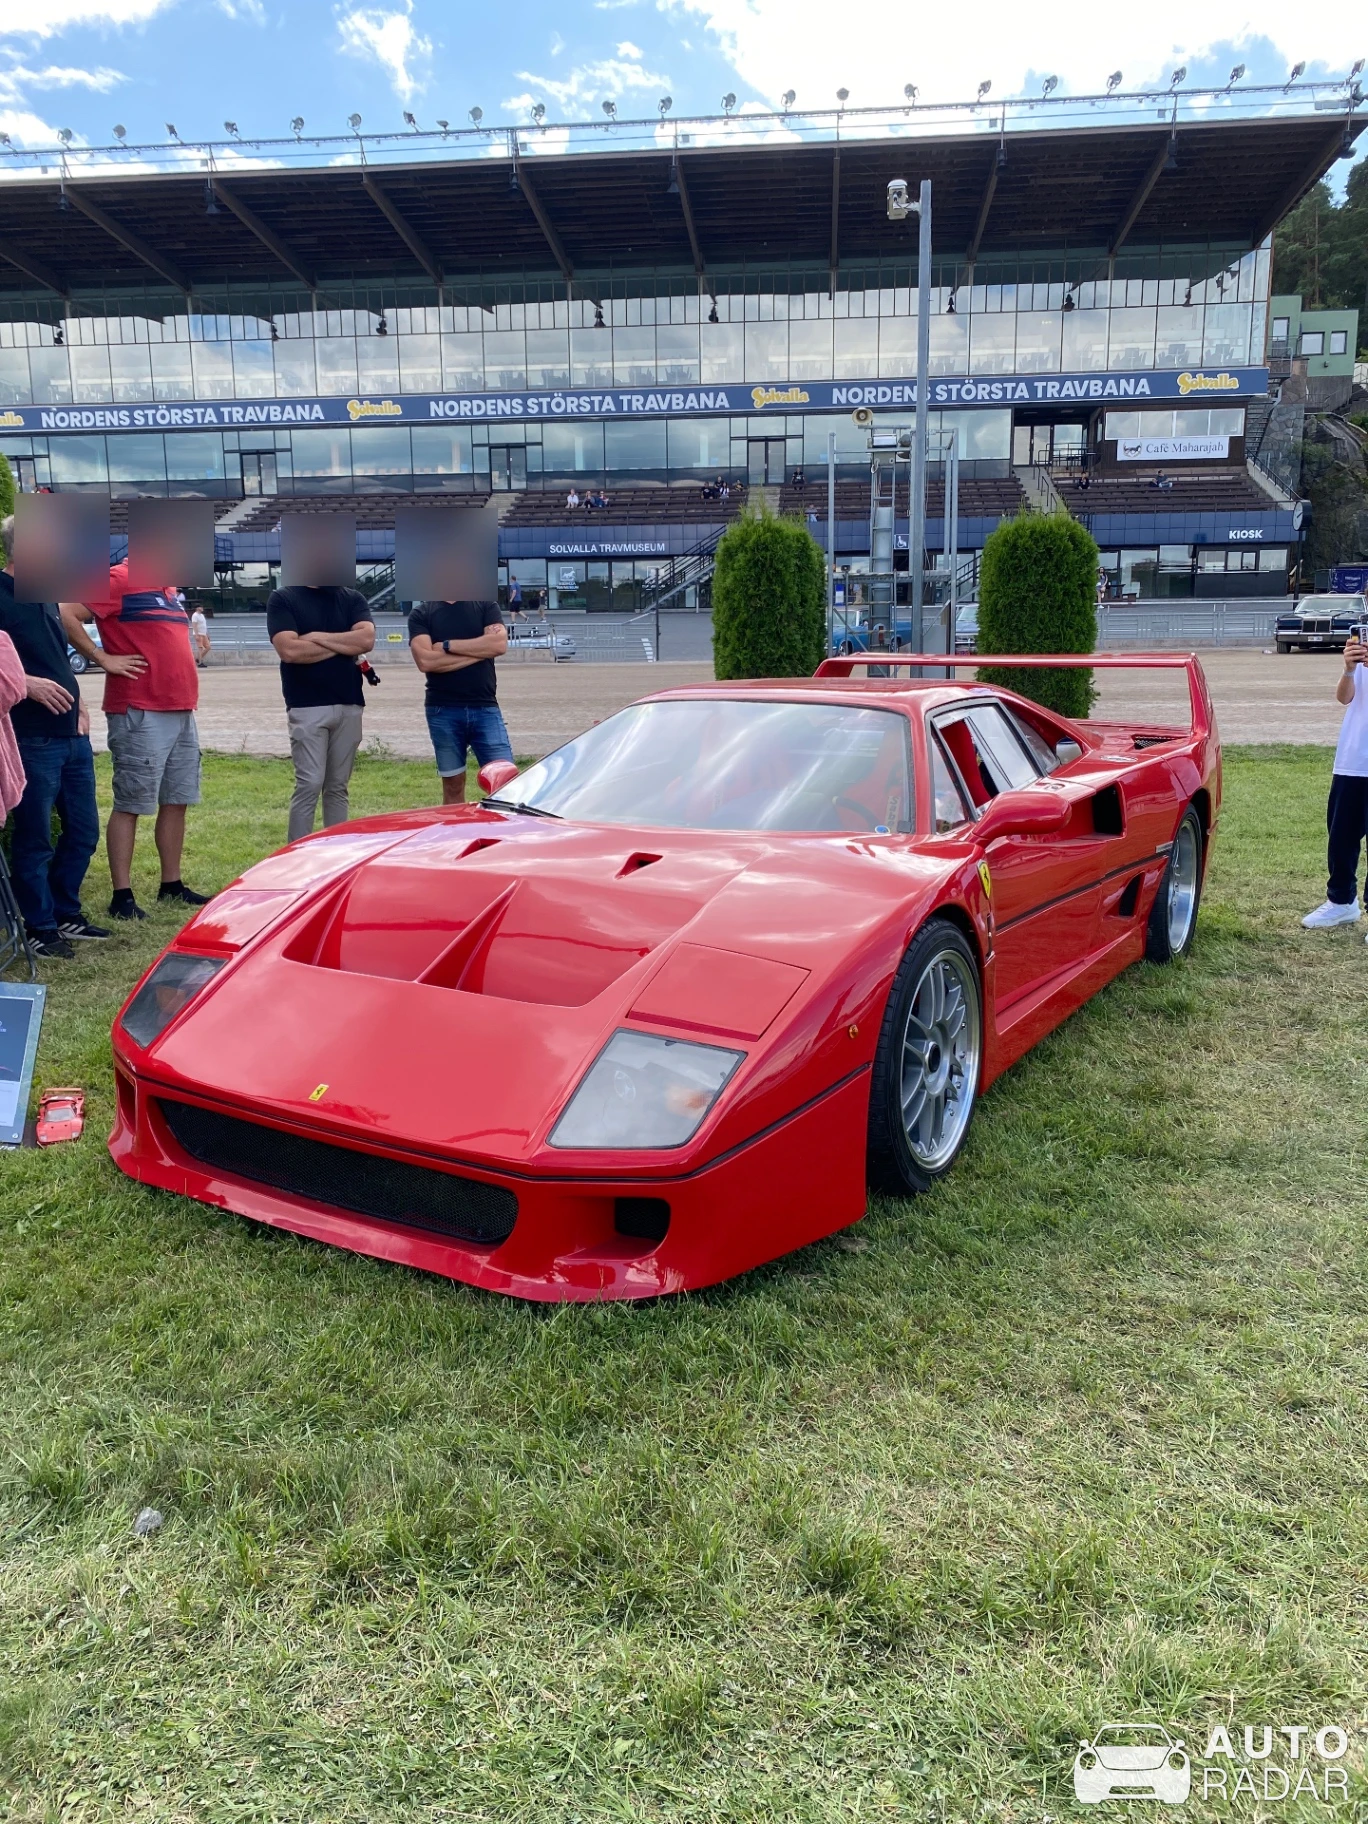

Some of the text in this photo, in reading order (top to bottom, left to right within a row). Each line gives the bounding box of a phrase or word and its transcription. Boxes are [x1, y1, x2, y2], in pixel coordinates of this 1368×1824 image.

[935, 379, 1029, 401] STÖRSTA
[1034, 378, 1151, 399] TRAVBANA
[1177, 372, 1239, 395] Solvalla
[430, 391, 730, 417] NORDENS STÖRSTA TRAVBANA
[751, 387, 810, 409] Solvalla
[41, 404, 325, 428] NORDENS STÖRSTA TRAVBANA
[347, 399, 402, 420] Solvalla
[1146, 442, 1224, 456] Café Maharajah
[1228, 529, 1264, 540] KIOSK
[549, 542, 666, 554] SOLVALLA TRAVMUSEUM
